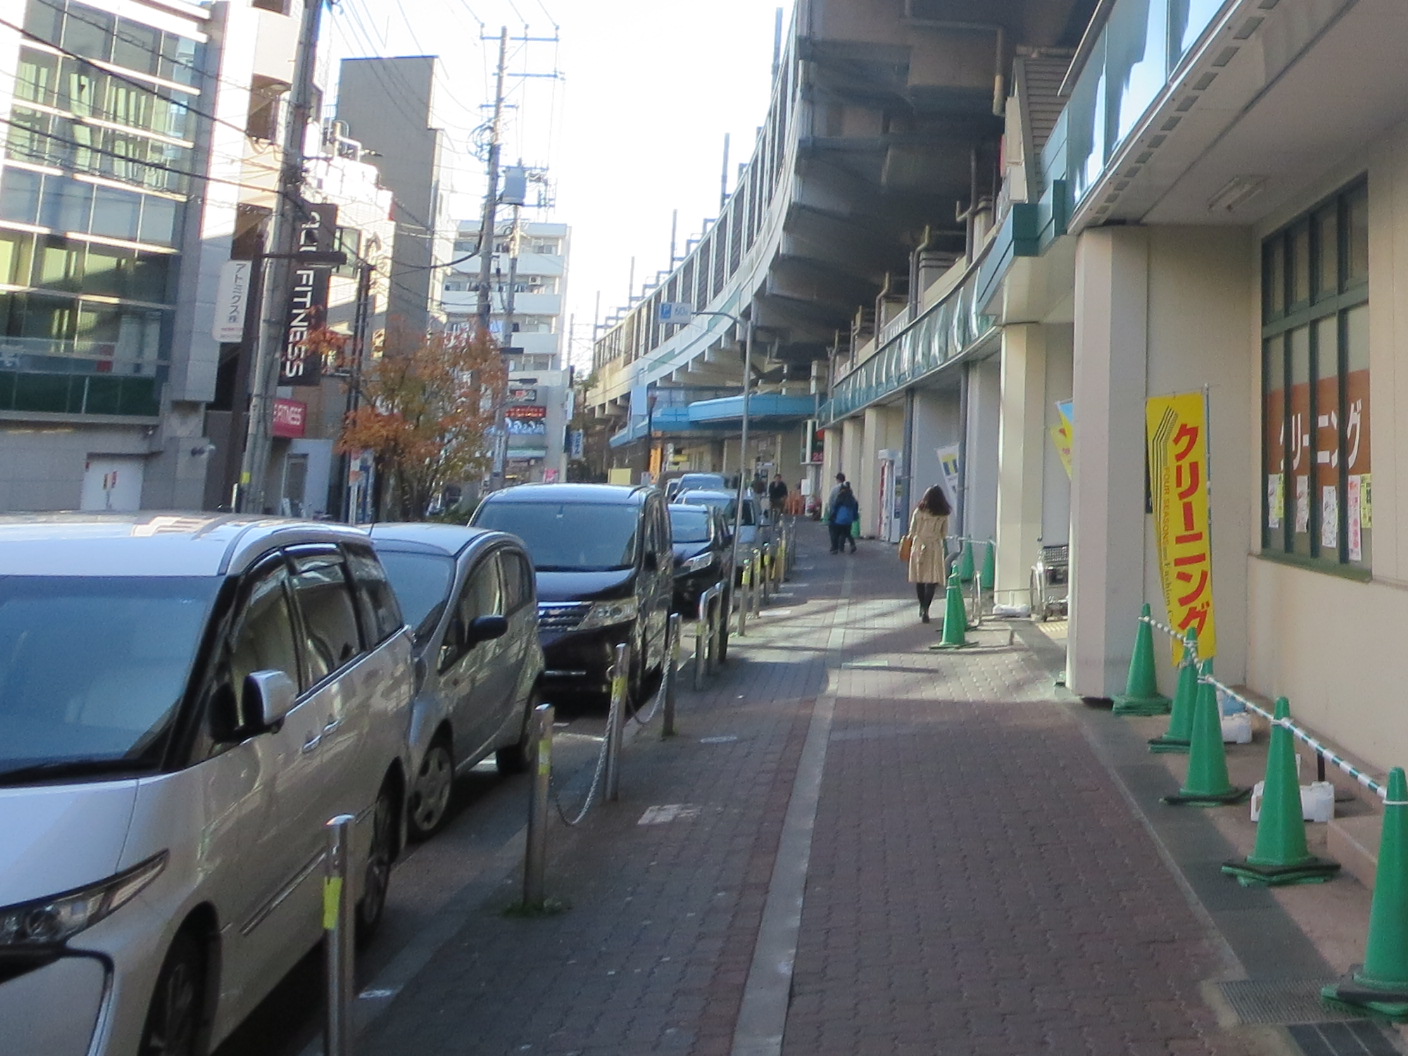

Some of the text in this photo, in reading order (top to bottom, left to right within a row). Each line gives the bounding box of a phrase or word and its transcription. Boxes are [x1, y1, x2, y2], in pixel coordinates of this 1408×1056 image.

[286, 269, 314, 378] FITNESS
[1279, 398, 1362, 472] リーニング
[1172, 423, 1211, 638] クリーニング
